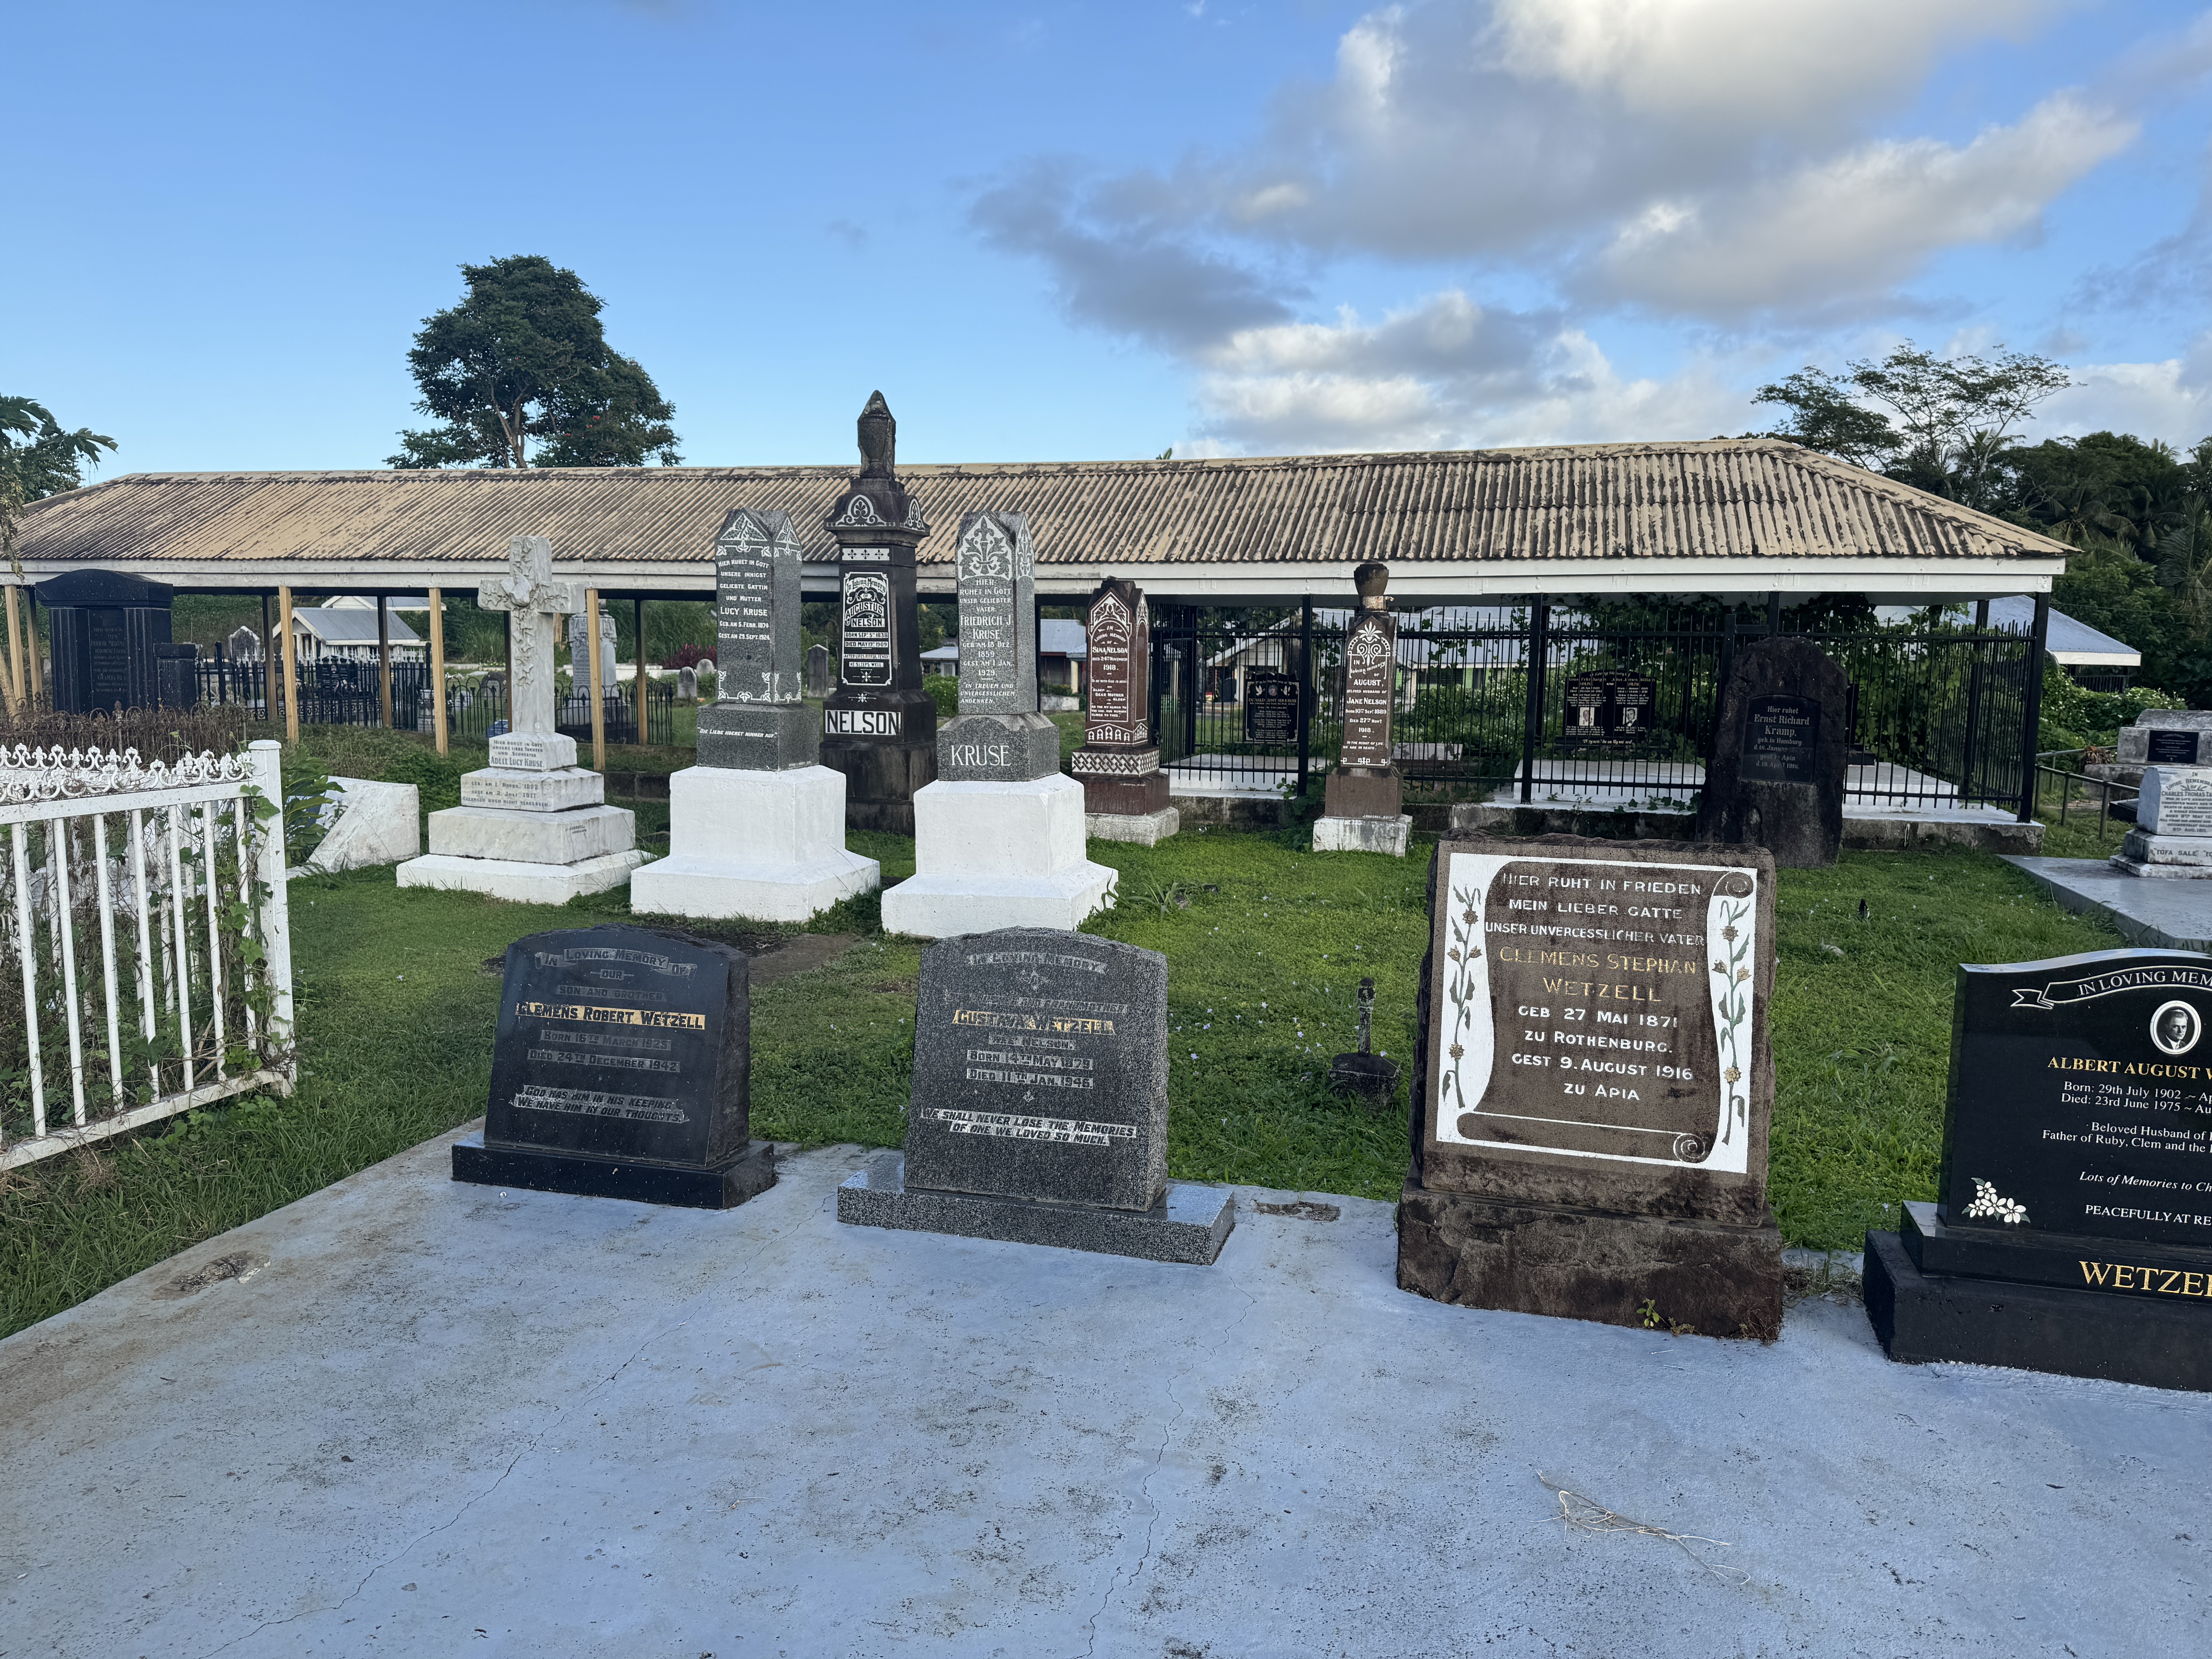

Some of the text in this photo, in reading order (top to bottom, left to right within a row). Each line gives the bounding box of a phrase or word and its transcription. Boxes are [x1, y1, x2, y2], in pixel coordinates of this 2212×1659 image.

[720, 606, 768, 616] LUCY KRUSE
[846, 602, 882, 619] AUGUSTUS
[960, 615, 1003, 626] FRIEDRICH
[973, 628, 1000, 639] KRUSE
[827, 710, 900, 735] NELSON
[1754, 714, 1810, 725] Ernst Richard
[510, 757, 522, 766] LUCY
[951, 745, 1012, 766] KRUSE
[1503, 872, 1702, 896] HIER RUHT IN FRIEDEN
[1509, 899, 1683, 919] MEIN LIEBER GATTE
[1485, 921, 1527, 934] UNSER
[1660, 933, 1705, 946] VATER
[546, 950, 685, 974] IN LOVING MEMORY OF
[1499, 946, 1696, 975] CLEMENS STEPHAN
[602, 970, 622, 979] OUR
[2078, 982, 2097, 996] IN
[2100, 971, 2166, 990] LOVING
[560, 986, 664, 1001] SON AND BROTHER
[1543, 977, 1662, 1002] WETZELL
[519, 1002, 703, 1029] CLEMENS ROBERT WETZELL
[1518, 1006, 1678, 1029] GEB 27 MAI 1871
[544, 1031, 668, 1050] BORN MARCH 1925
[1524, 1030, 1545, 1042] ZU
[530, 1049, 677, 1072] DIED DECEMBER 1942
[970, 1051, 1000, 1062] BORN
[970, 1069, 996, 1080] DIED
[1511, 1053, 1694, 1080] GEST AUGUST 1916
[2047, 1056, 2121, 1073] ALBERT
[2124, 1062, 2200, 1079] AUGUST
[526, 1086, 672, 1109] GOD HAS HIM IN HIS KEEPING
[1564, 1083, 1640, 1101] ZU APIA
[2064, 1081, 2181, 1099] Born: 29th July 1902
[519, 1097, 533, 1108] WE
[536, 1100, 560, 1110] HAVE
[563, 1103, 582, 1113] HIM
[586, 1105, 598, 1114] IN
[601, 1107, 621, 1116] OUR
[2061, 1093, 2181, 1111] Died: 23rd June 1975
[941, 1111, 1135, 1137] SHALL NEVER LOSE THE MEMORIES
[953, 1123, 968, 1132] OF
[970, 1125, 991, 1134] ONE
[996, 1127, 1012, 1136] WE
[1015, 1128, 1051, 1140] LOVED
[1054, 1132, 1070, 1141] SO
[2091, 1122, 2207, 1140] Beloved Husband of
[2043, 1130, 2206, 1152] Father of Ruby, Clem and the
[2080, 1171, 2104, 1182] Lots
[2107, 1175, 2121, 1185] of
[2121, 1175, 2178, 1189] Memories
[2085, 1204, 2191, 1223] PEACEFULLY AT
